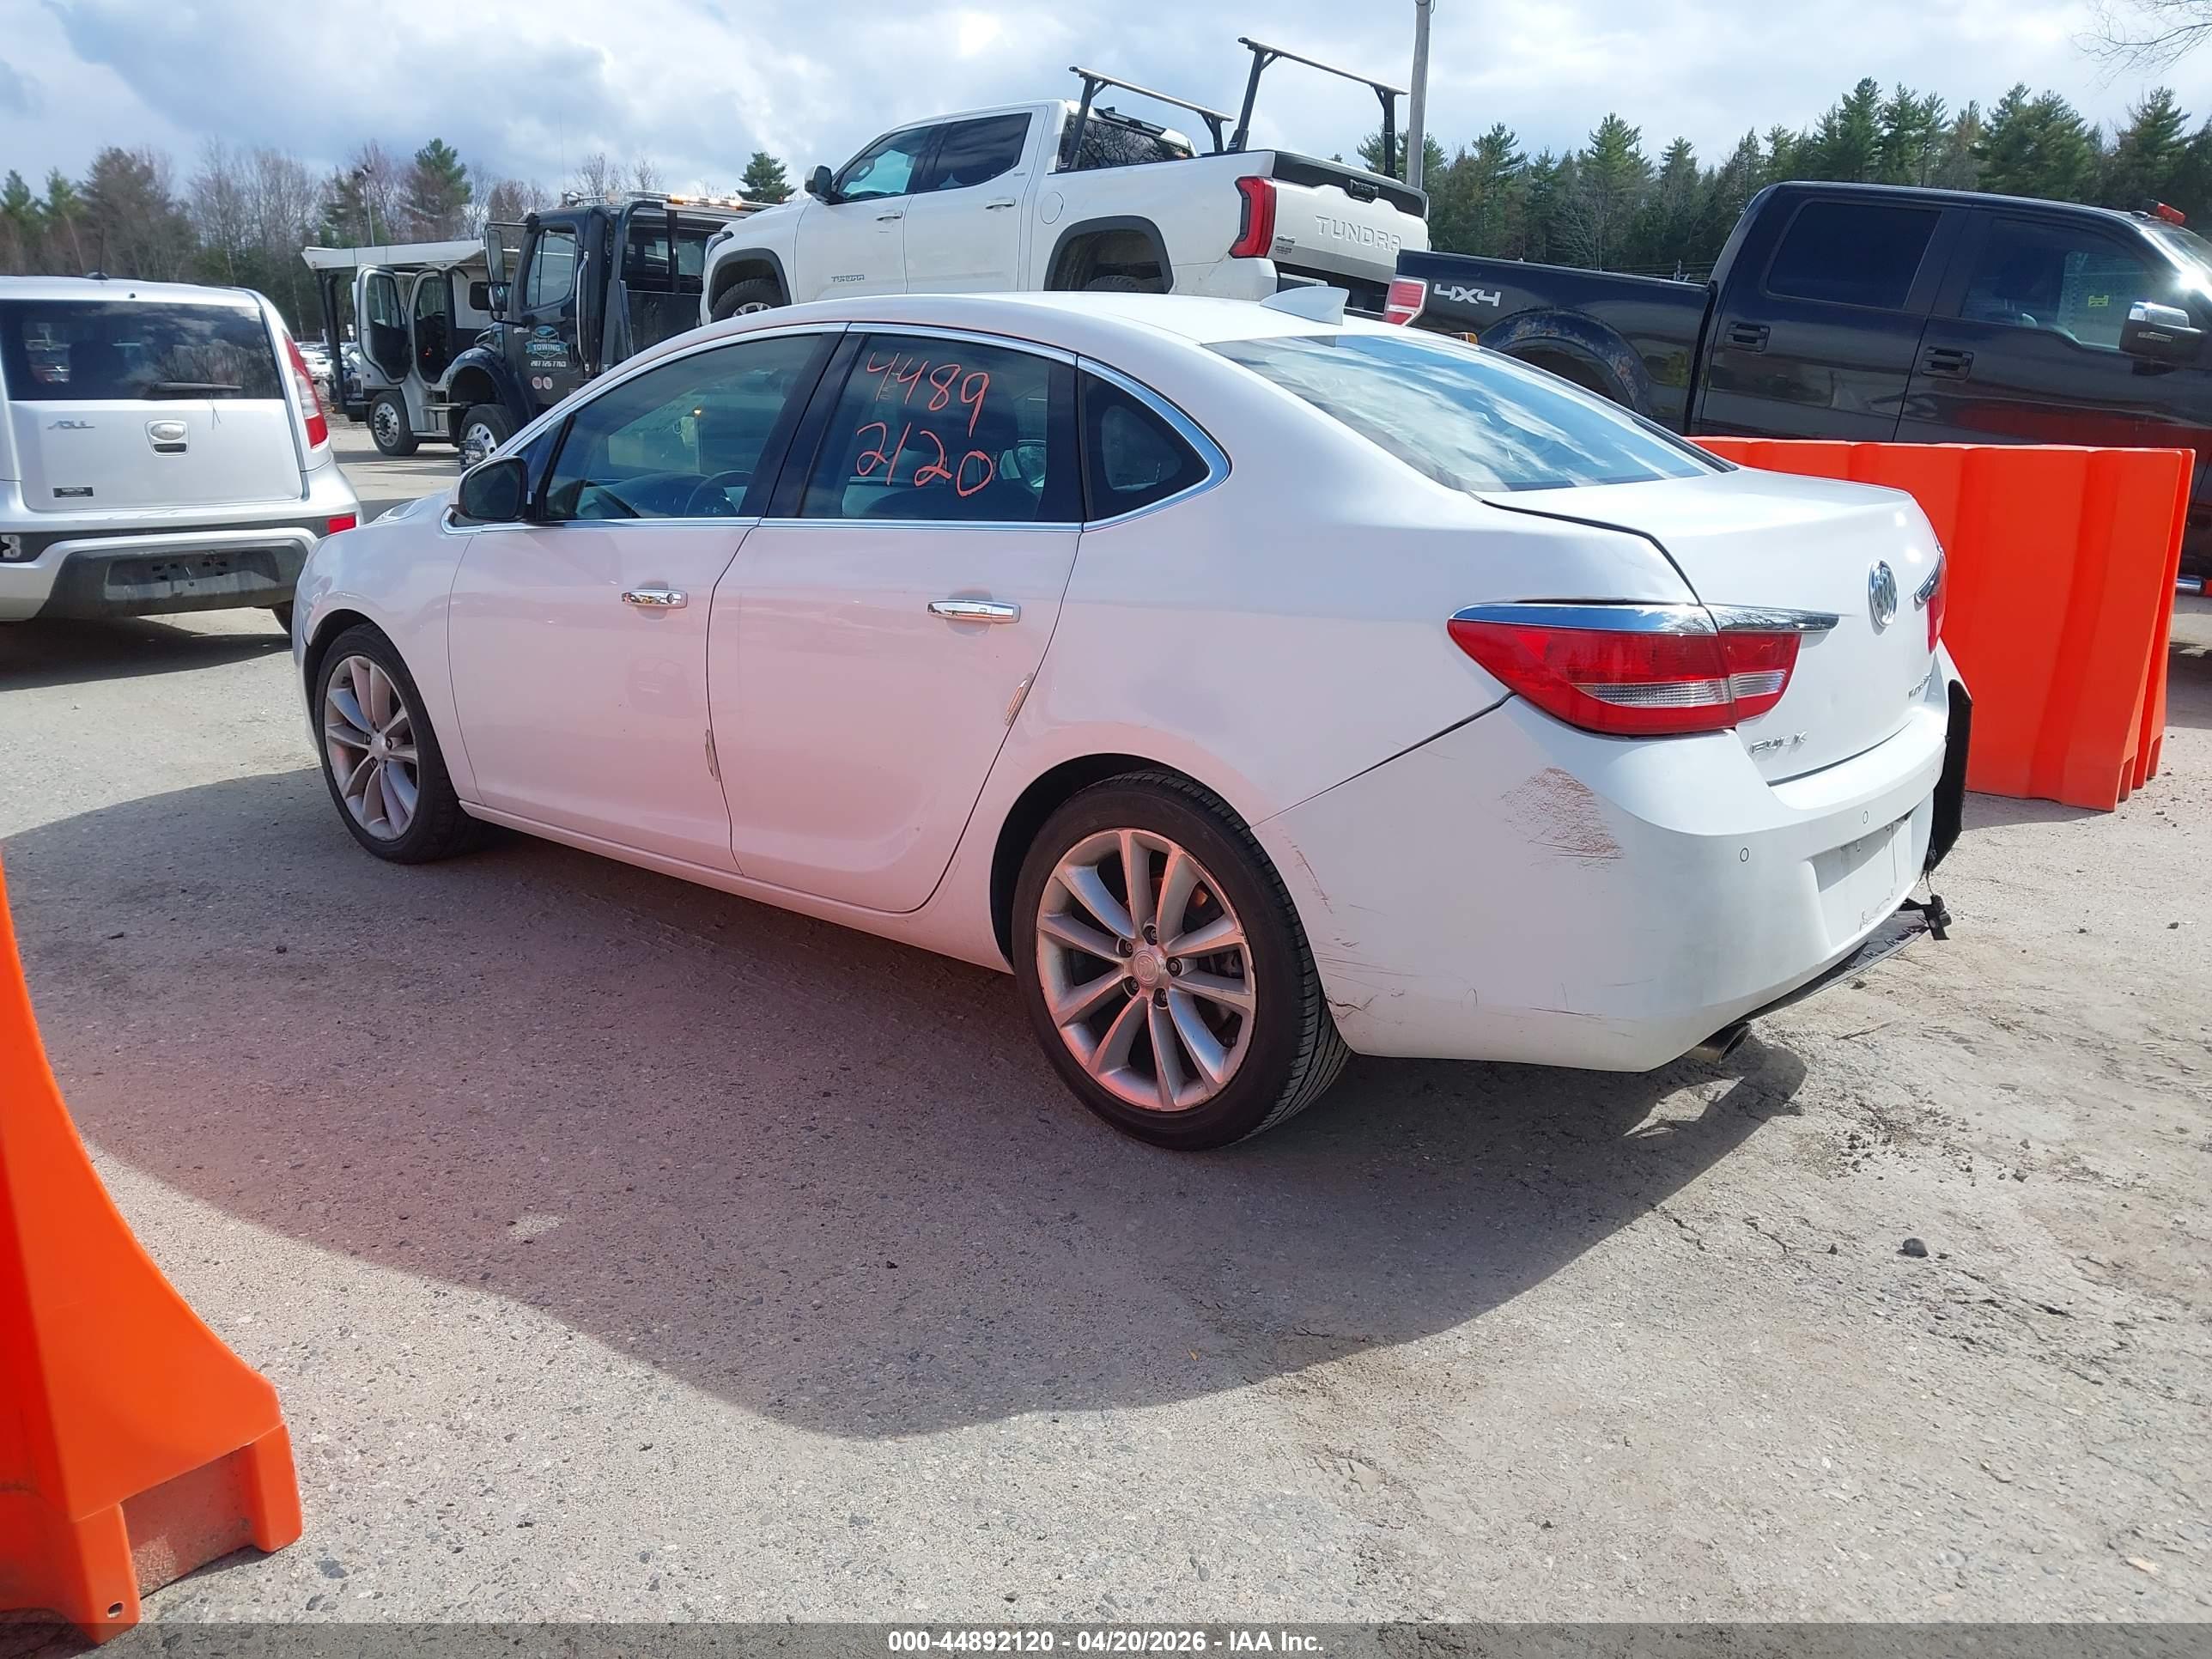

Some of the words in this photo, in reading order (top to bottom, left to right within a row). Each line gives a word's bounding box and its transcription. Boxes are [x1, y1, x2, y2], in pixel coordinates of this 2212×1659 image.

[1314, 215, 1402, 255] TUNDRA
[1433, 283, 1502, 307] 4X4
[866, 351, 989, 438] 4489
[856, 421, 994, 498] 2120
